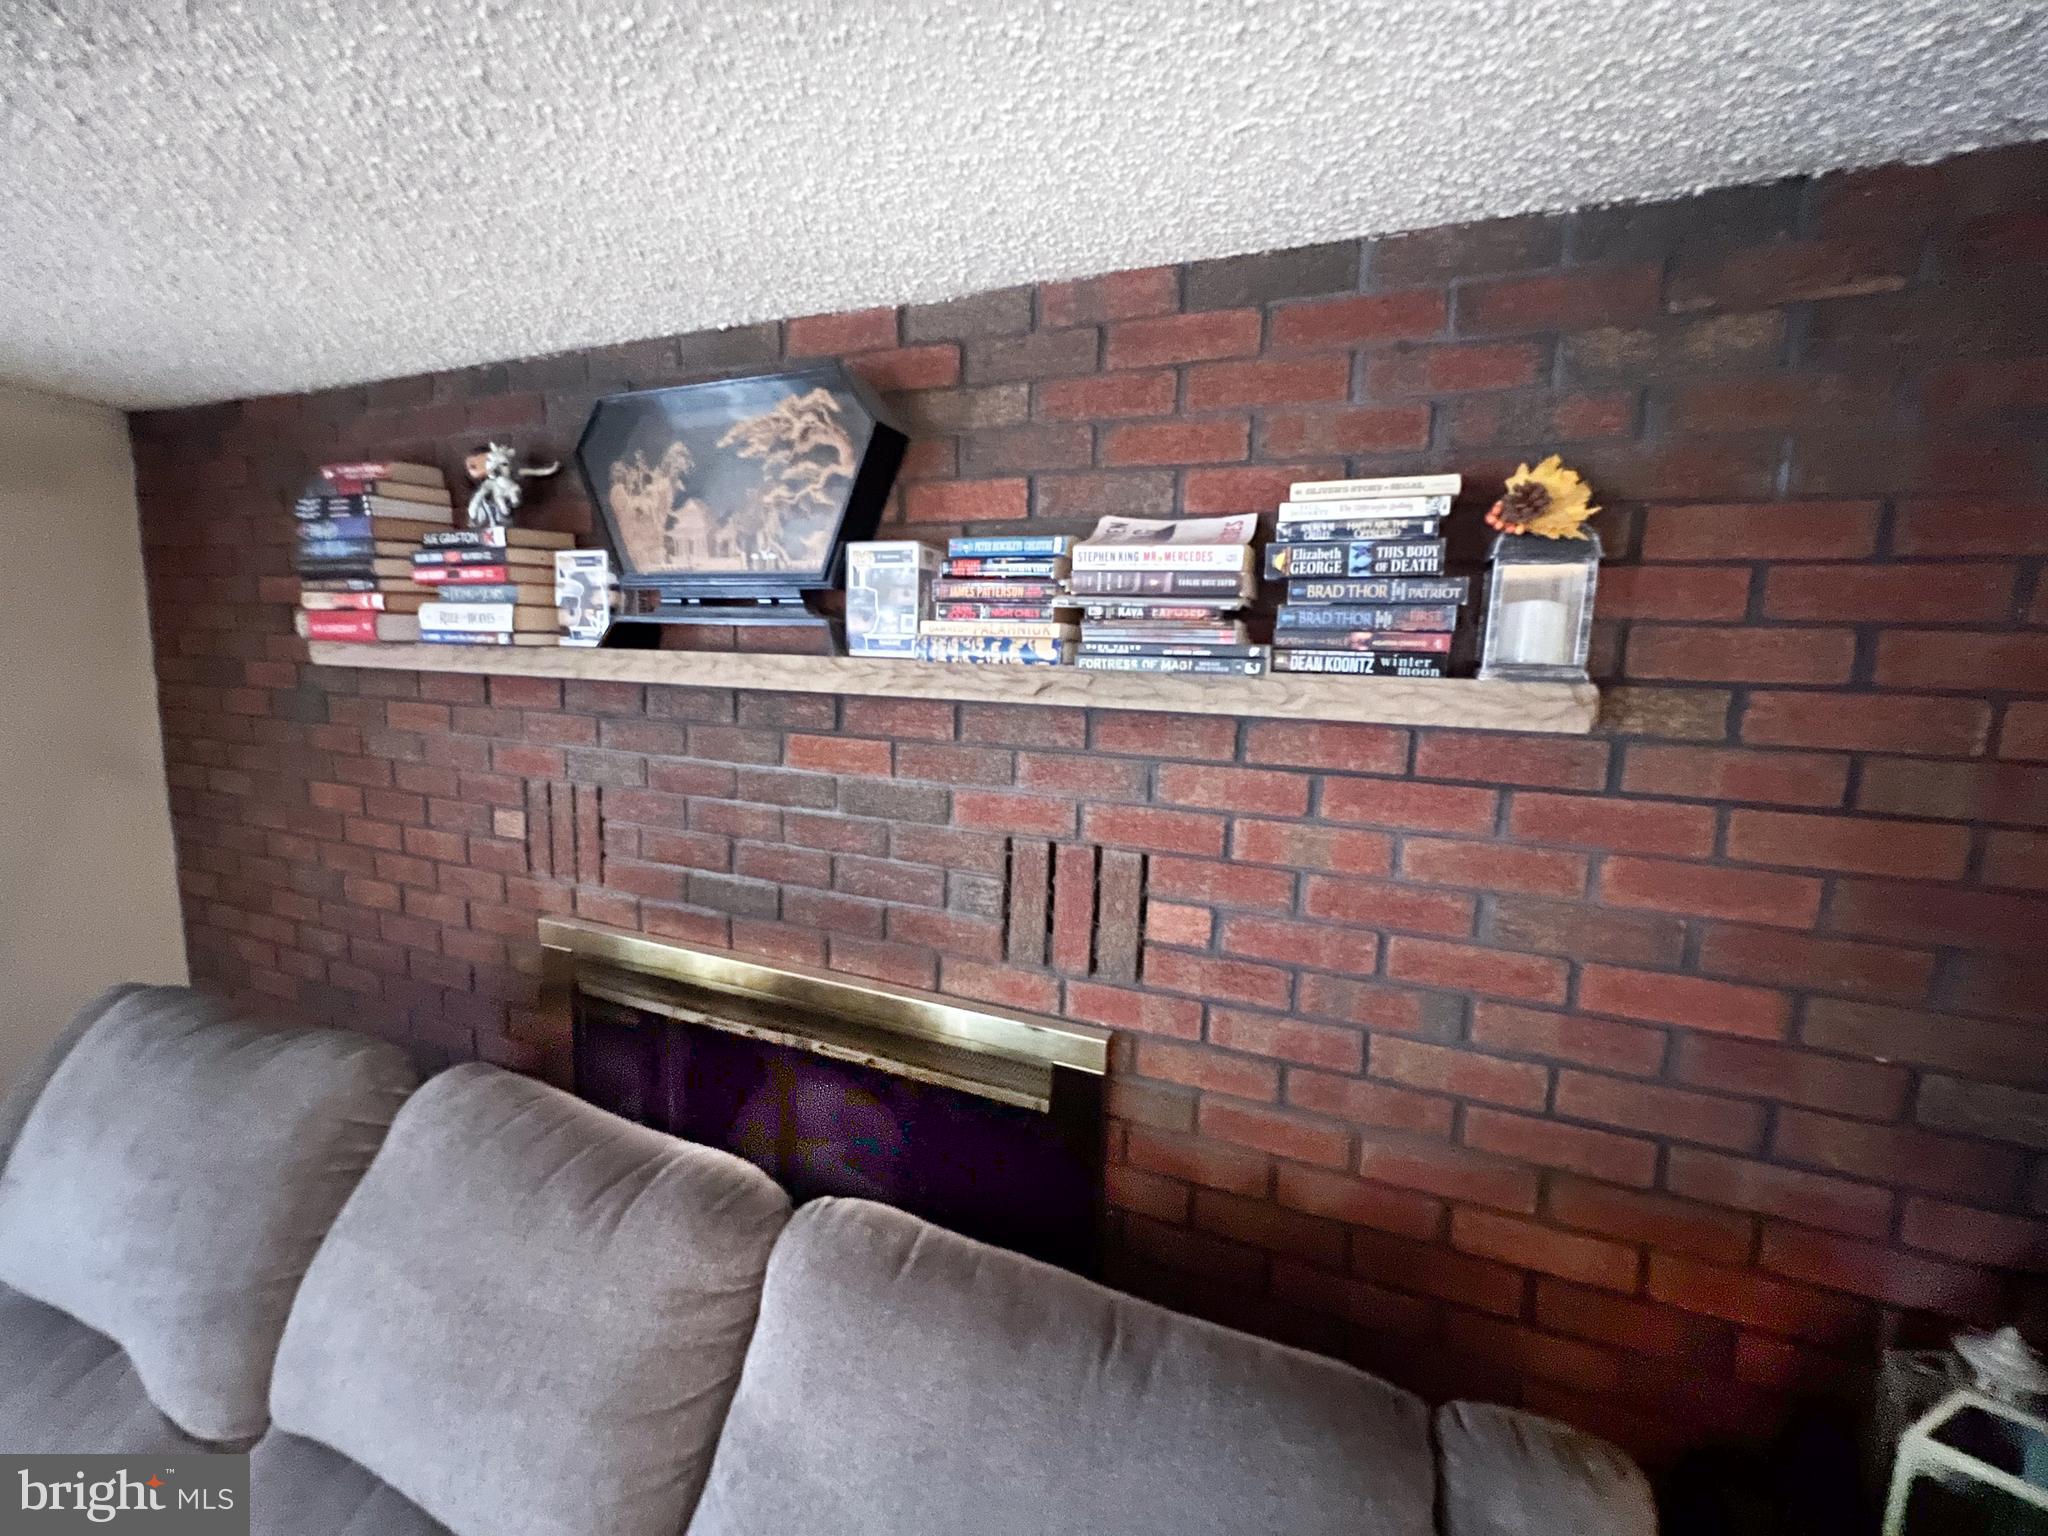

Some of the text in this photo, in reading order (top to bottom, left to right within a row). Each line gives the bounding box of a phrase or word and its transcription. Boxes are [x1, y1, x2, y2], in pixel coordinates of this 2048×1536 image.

[1078, 551, 1116, 562] STEPHEN
[1119, 551, 1140, 562] KING
[1164, 550, 1214, 562] MERCEDES
[1292, 547, 1341, 560] Elizabeth
[1376, 545, 1440, 558] THIS BODY
[1290, 561, 1342, 574] GEORGE
[1390, 558, 1438, 572] DEATH
[950, 586, 975, 598] JAMES
[976, 586, 1025, 598] PATTERSON
[1306, 584, 1462, 599] BRAD THOR PATRIOT
[1118, 606, 1144, 617] KAVA
[1300, 611, 1334, 624] BRAD
[1335, 612, 1372, 625] THOR
[1078, 657, 1138, 671] FORTRESS
[1142, 659, 1157, 670] OF
[1290, 656, 1375, 674] DEAN KOONTZ
[1380, 654, 1433, 667] winter
[1397, 666, 1440, 677] moon
